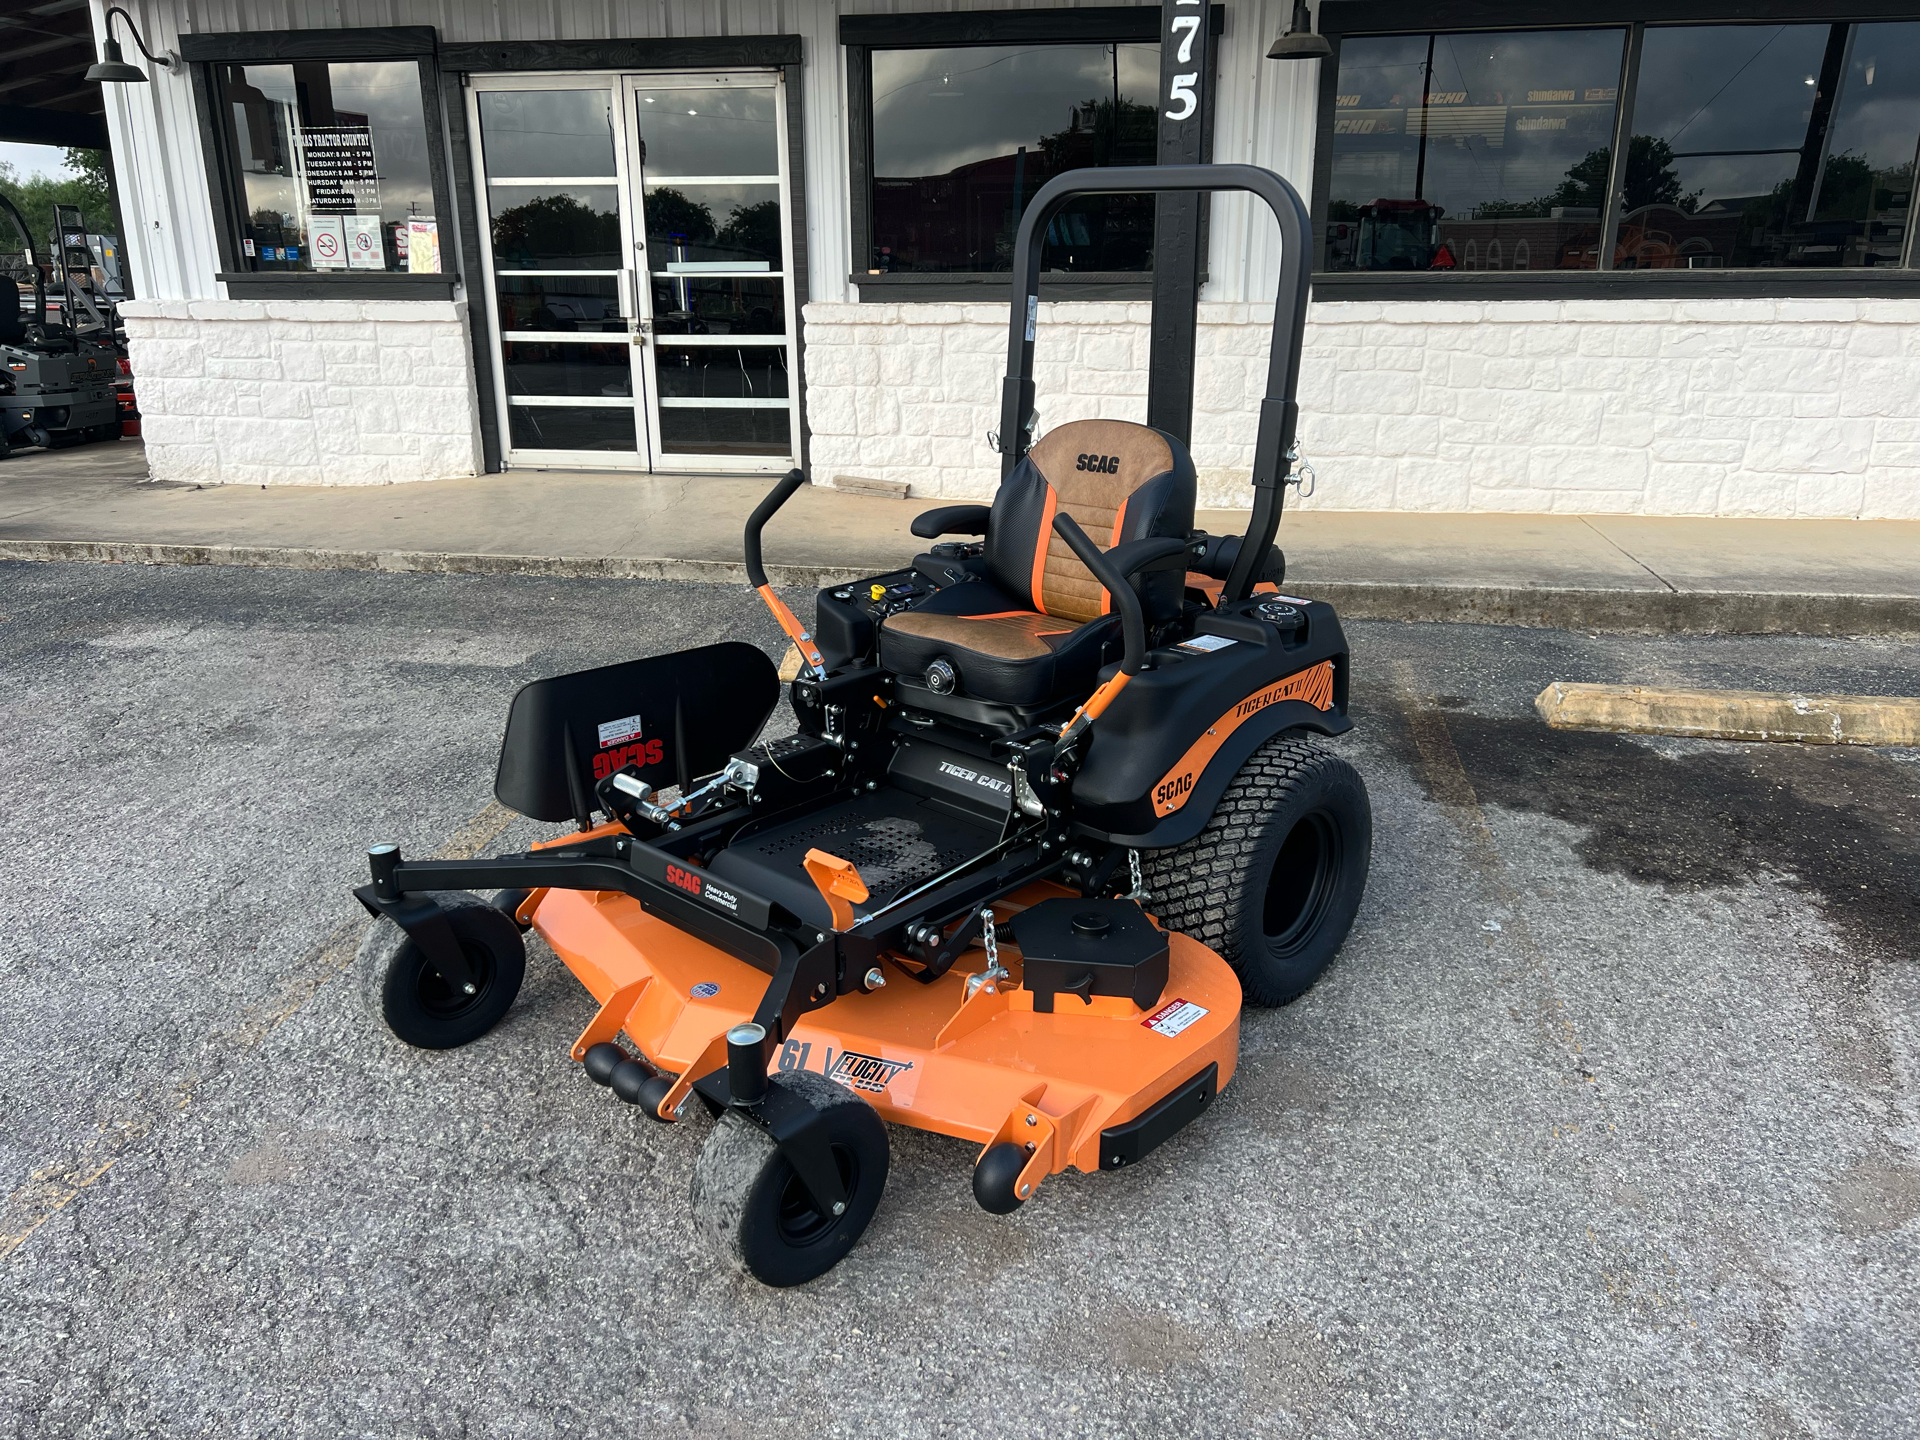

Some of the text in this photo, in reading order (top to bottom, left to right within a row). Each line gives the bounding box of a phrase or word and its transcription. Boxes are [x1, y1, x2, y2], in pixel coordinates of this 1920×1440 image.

[313, 134, 341, 147] TRACTOR
[341, 133, 369, 147] COUNTRY
[1334, 119, 1377, 135] CHO
[1076, 453, 1120, 475] SCAG
[1236, 692, 1272, 718] TIGER
[1273, 681, 1297, 702] CAT
[592, 739, 663, 780] SCAG
[939, 761, 978, 782] TIGER
[977, 775, 1006, 792] CAT
[1157, 772, 1193, 805] SCAG
[666, 864, 702, 895] SCAG
[705, 883, 738, 903] Heavy-Duty
[704, 890, 738, 911] Commercial
[1156, 1001, 1184, 1020] DANGER
[778, 1038, 812, 1071] 61
[823, 1046, 904, 1084] VELOCITY
